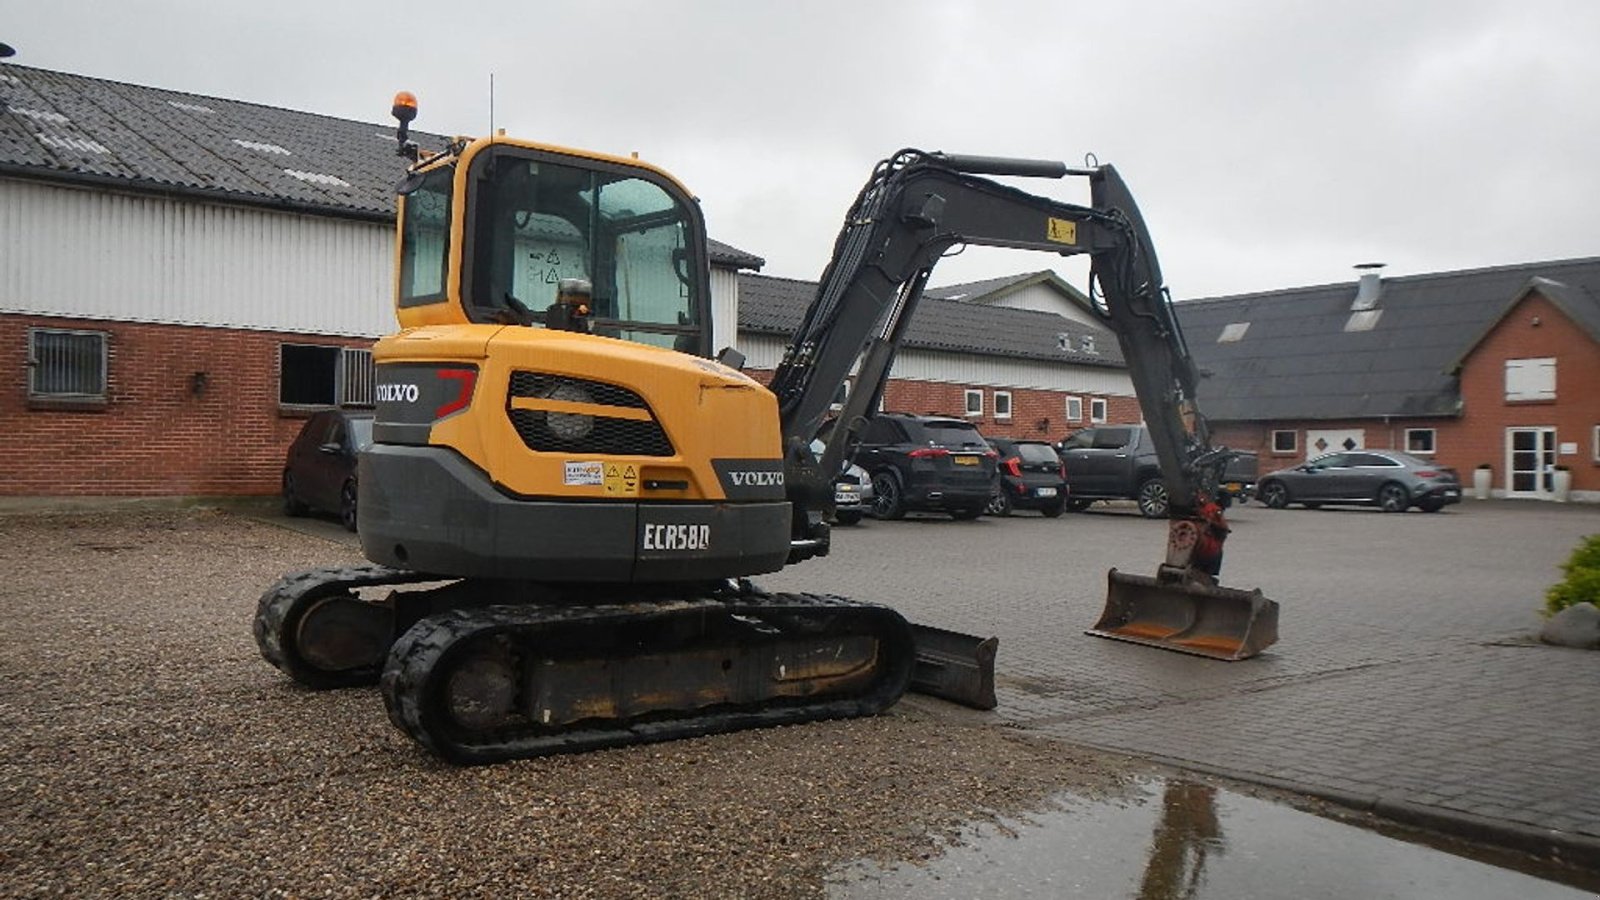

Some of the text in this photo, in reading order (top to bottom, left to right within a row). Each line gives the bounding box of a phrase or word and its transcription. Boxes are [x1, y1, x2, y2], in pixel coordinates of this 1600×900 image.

[376, 384, 419, 402] VOLVO
[728, 471, 784, 486] VOLVO
[644, 523, 711, 550] ECR58D
